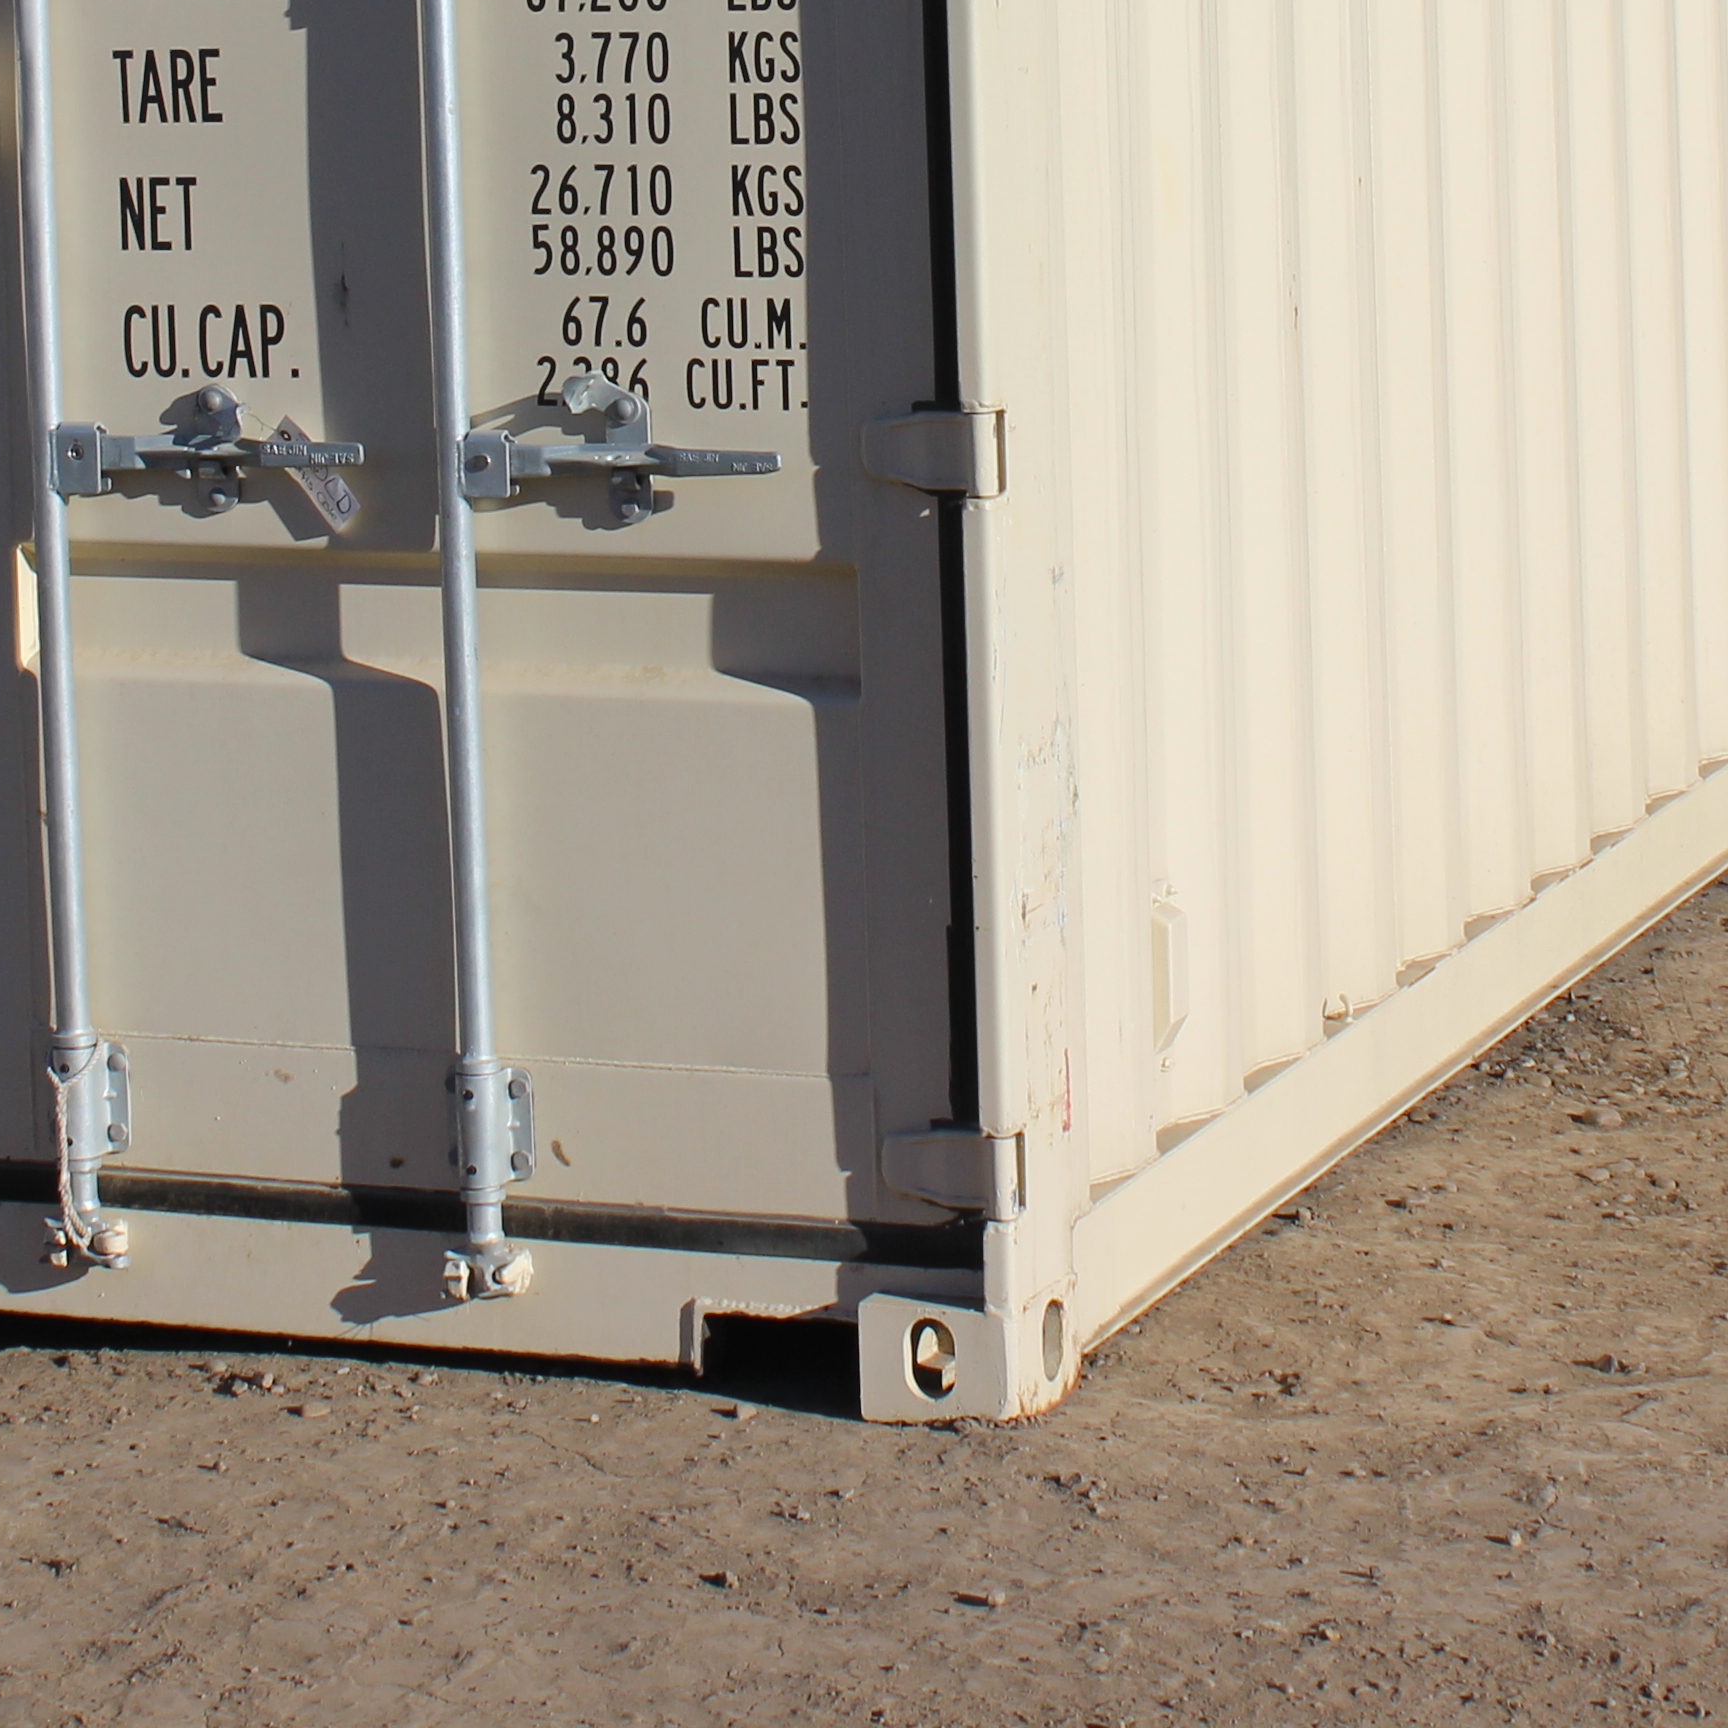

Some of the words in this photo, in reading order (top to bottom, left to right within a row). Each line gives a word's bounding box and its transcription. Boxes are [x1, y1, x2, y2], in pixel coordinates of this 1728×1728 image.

[112, 47, 225, 125] TARE
[554, 31, 670, 86] 3,770
[728, 30, 802, 84] KGS
[556, 92, 672, 147] 8,310
[729, 92, 803, 146] LBS
[119, 175, 198, 252] NET
[530, 163, 674, 218] 26,710
[731, 164, 805, 218] KGS
[531, 224, 675, 278] 58,890
[733, 226, 806, 278] LBS
[561, 296, 649, 349] 67.6
[700, 296, 808, 350] CU.M.
[685, 358, 810, 411] CU.FT.
